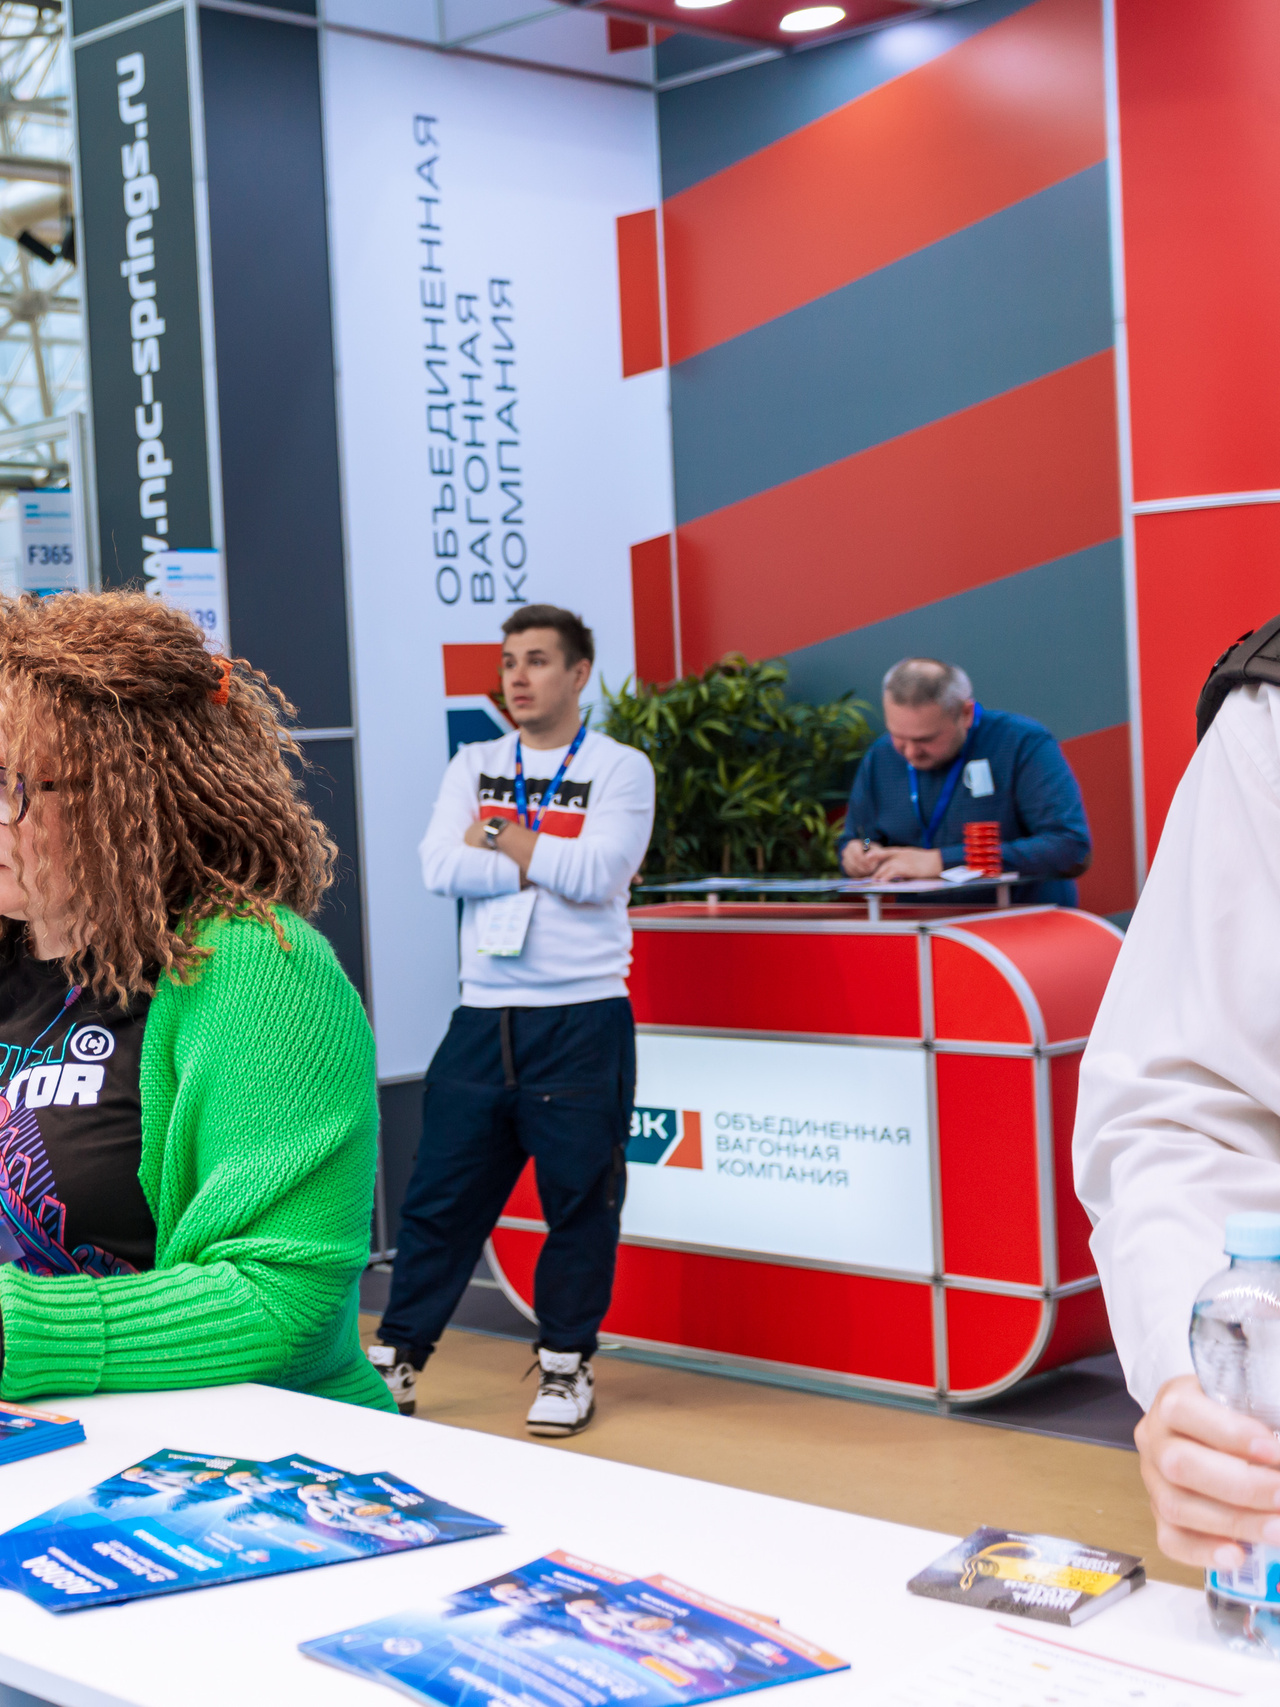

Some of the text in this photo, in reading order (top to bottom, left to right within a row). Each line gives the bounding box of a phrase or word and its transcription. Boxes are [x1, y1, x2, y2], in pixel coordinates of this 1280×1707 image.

[413, 113, 462, 605] ОБЪЕДИНЕННАЯ
[455, 294, 495, 605] ВАГОННАЯ
[488, 278, 528, 605] КОМПАНИЯ
[28, 544, 73, 565] F365
[714, 1111, 911, 1146] ОБЪЕДИНЕННАЯ
[716, 1135, 840, 1163] ВАГОННАЯ
[717, 1158, 849, 1188] КОМПАНИЯ
